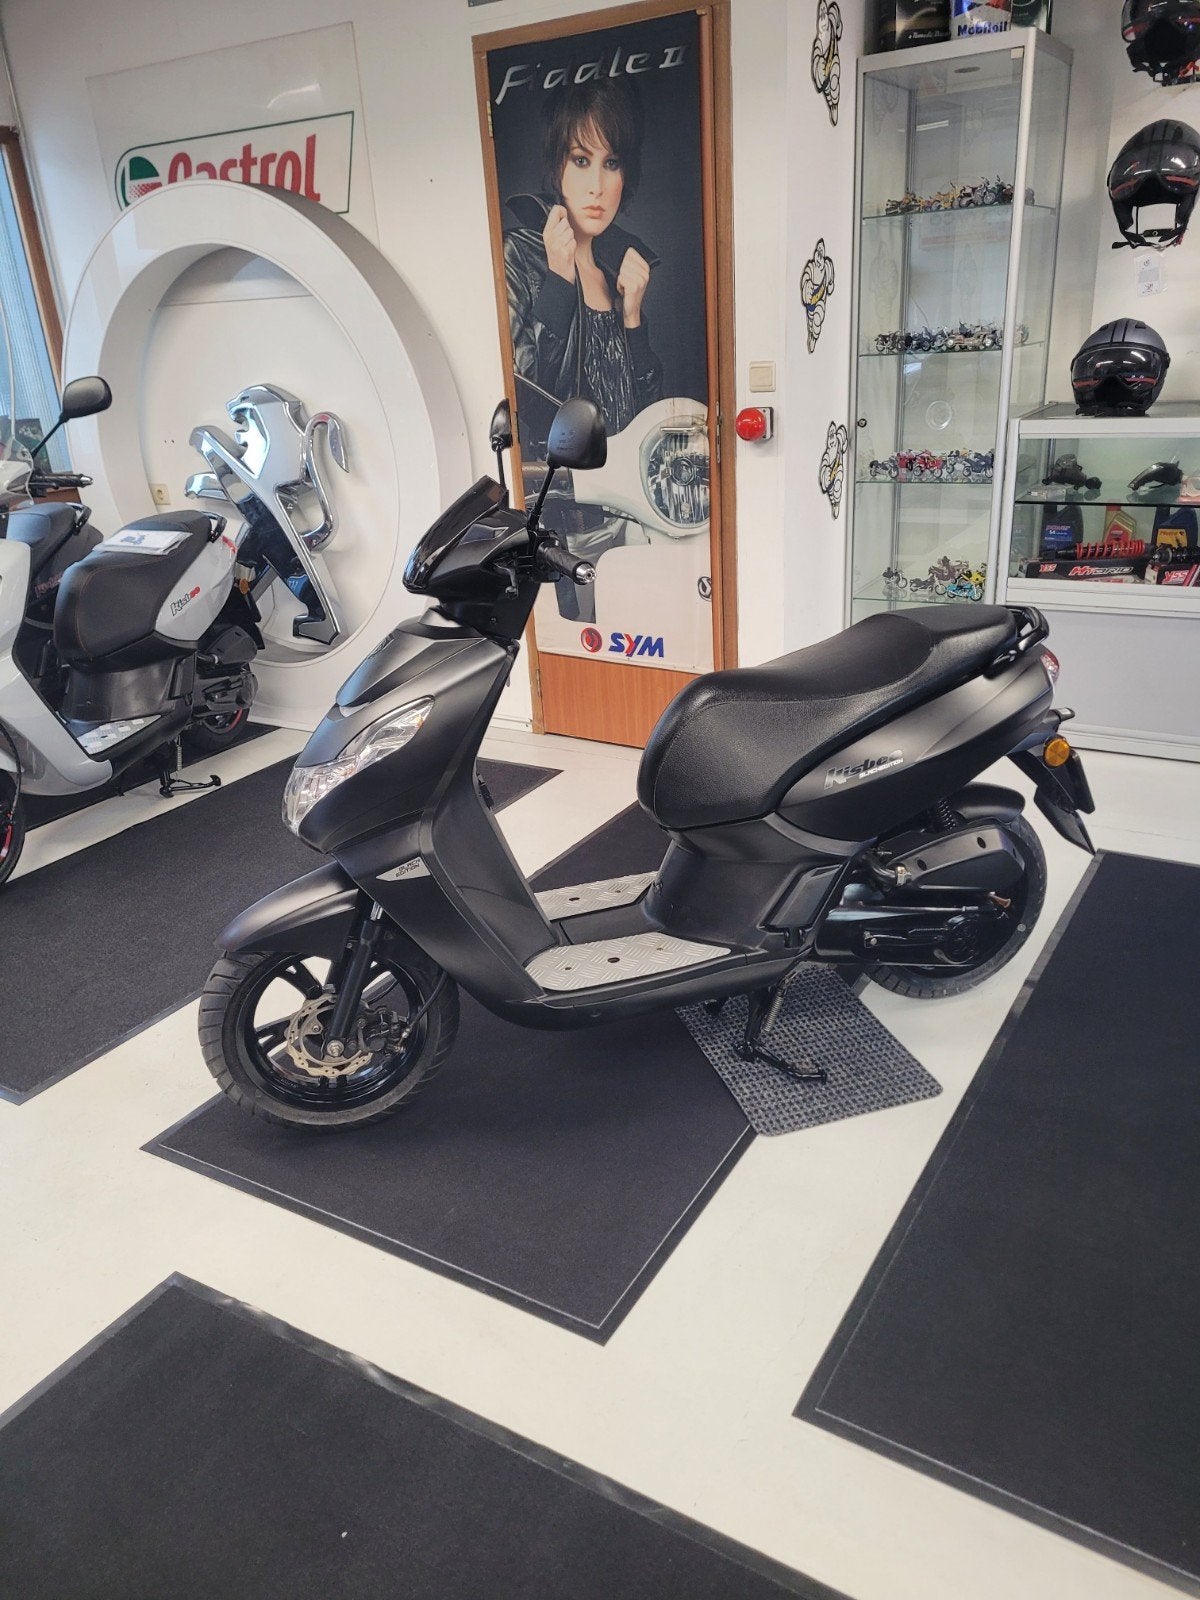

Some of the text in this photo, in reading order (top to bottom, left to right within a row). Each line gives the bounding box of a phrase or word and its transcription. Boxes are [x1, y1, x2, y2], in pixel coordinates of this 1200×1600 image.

[957, 20, 1008, 37] Mobiloil
[1039, 563, 1058, 573] YSS
[1163, 570, 1189, 583] YSS
[608, 632, 664, 658] SYM
